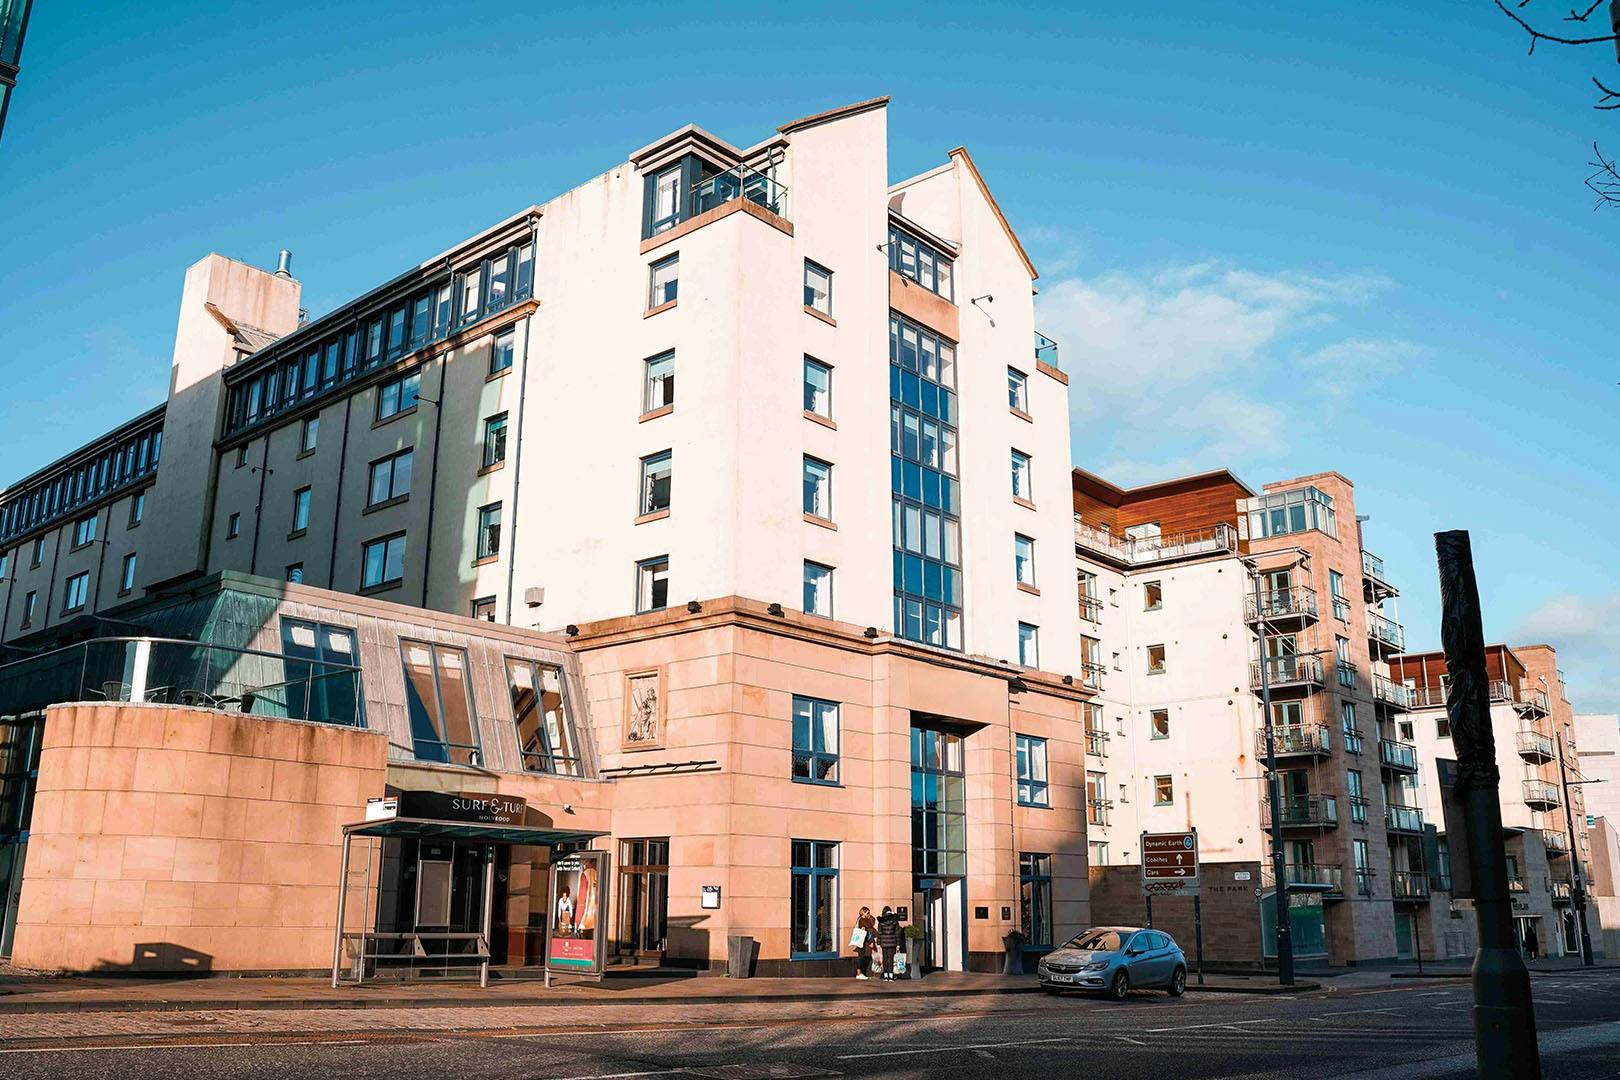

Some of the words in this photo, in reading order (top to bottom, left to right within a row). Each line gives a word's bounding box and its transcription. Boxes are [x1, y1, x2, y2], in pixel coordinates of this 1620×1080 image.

[452, 798, 488, 811] SURF
[490, 798, 503, 814] &
[1145, 840, 1167, 848] Dynamic
